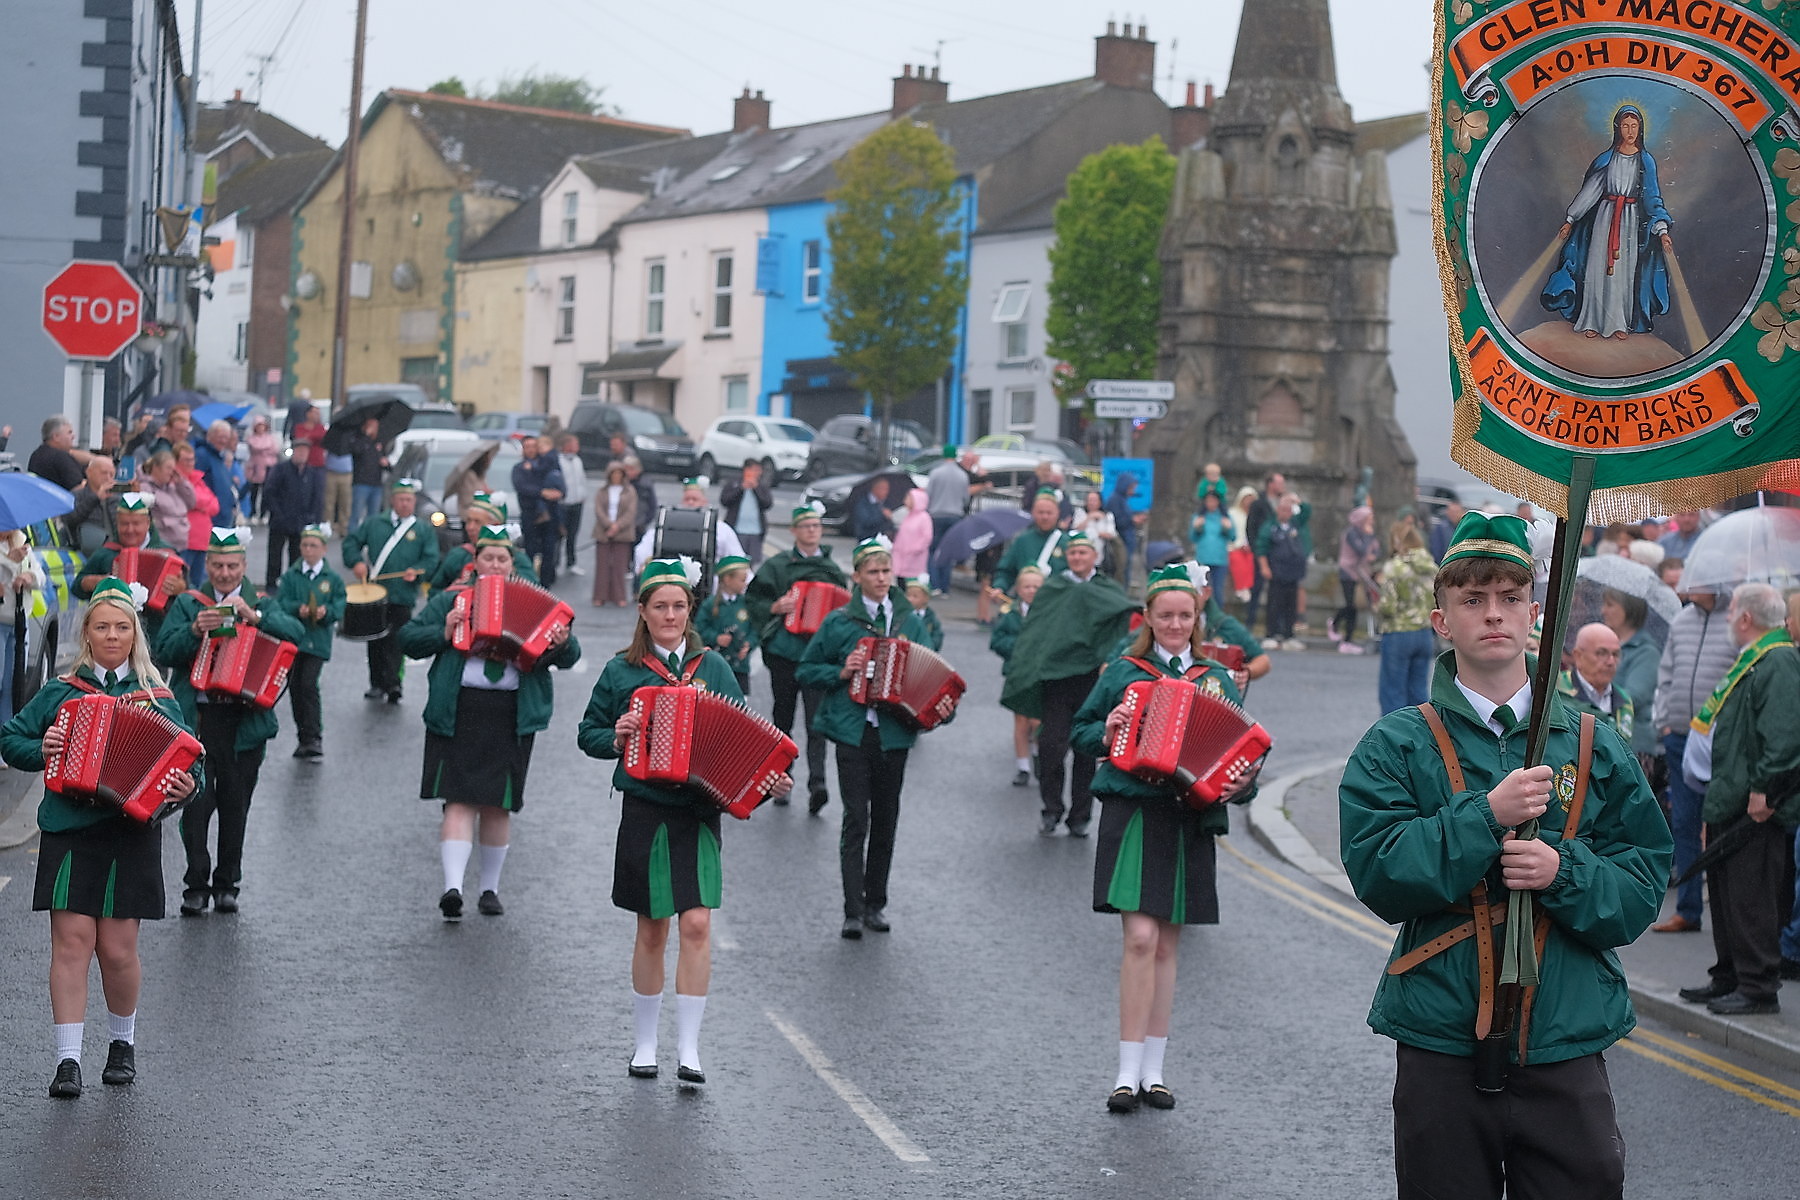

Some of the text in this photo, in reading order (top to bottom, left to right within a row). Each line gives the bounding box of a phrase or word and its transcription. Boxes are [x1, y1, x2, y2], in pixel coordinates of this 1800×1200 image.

[1479, 0, 1586, 51] GLEN
[1627, 41, 1687, 72] DIV
[1691, 59, 1757, 110] 367
[48, 294, 136, 325] STOP
[1478, 374, 1713, 445] ACCORDION BAND
[1492, 358, 1705, 424] SAINT PATRICK'S
